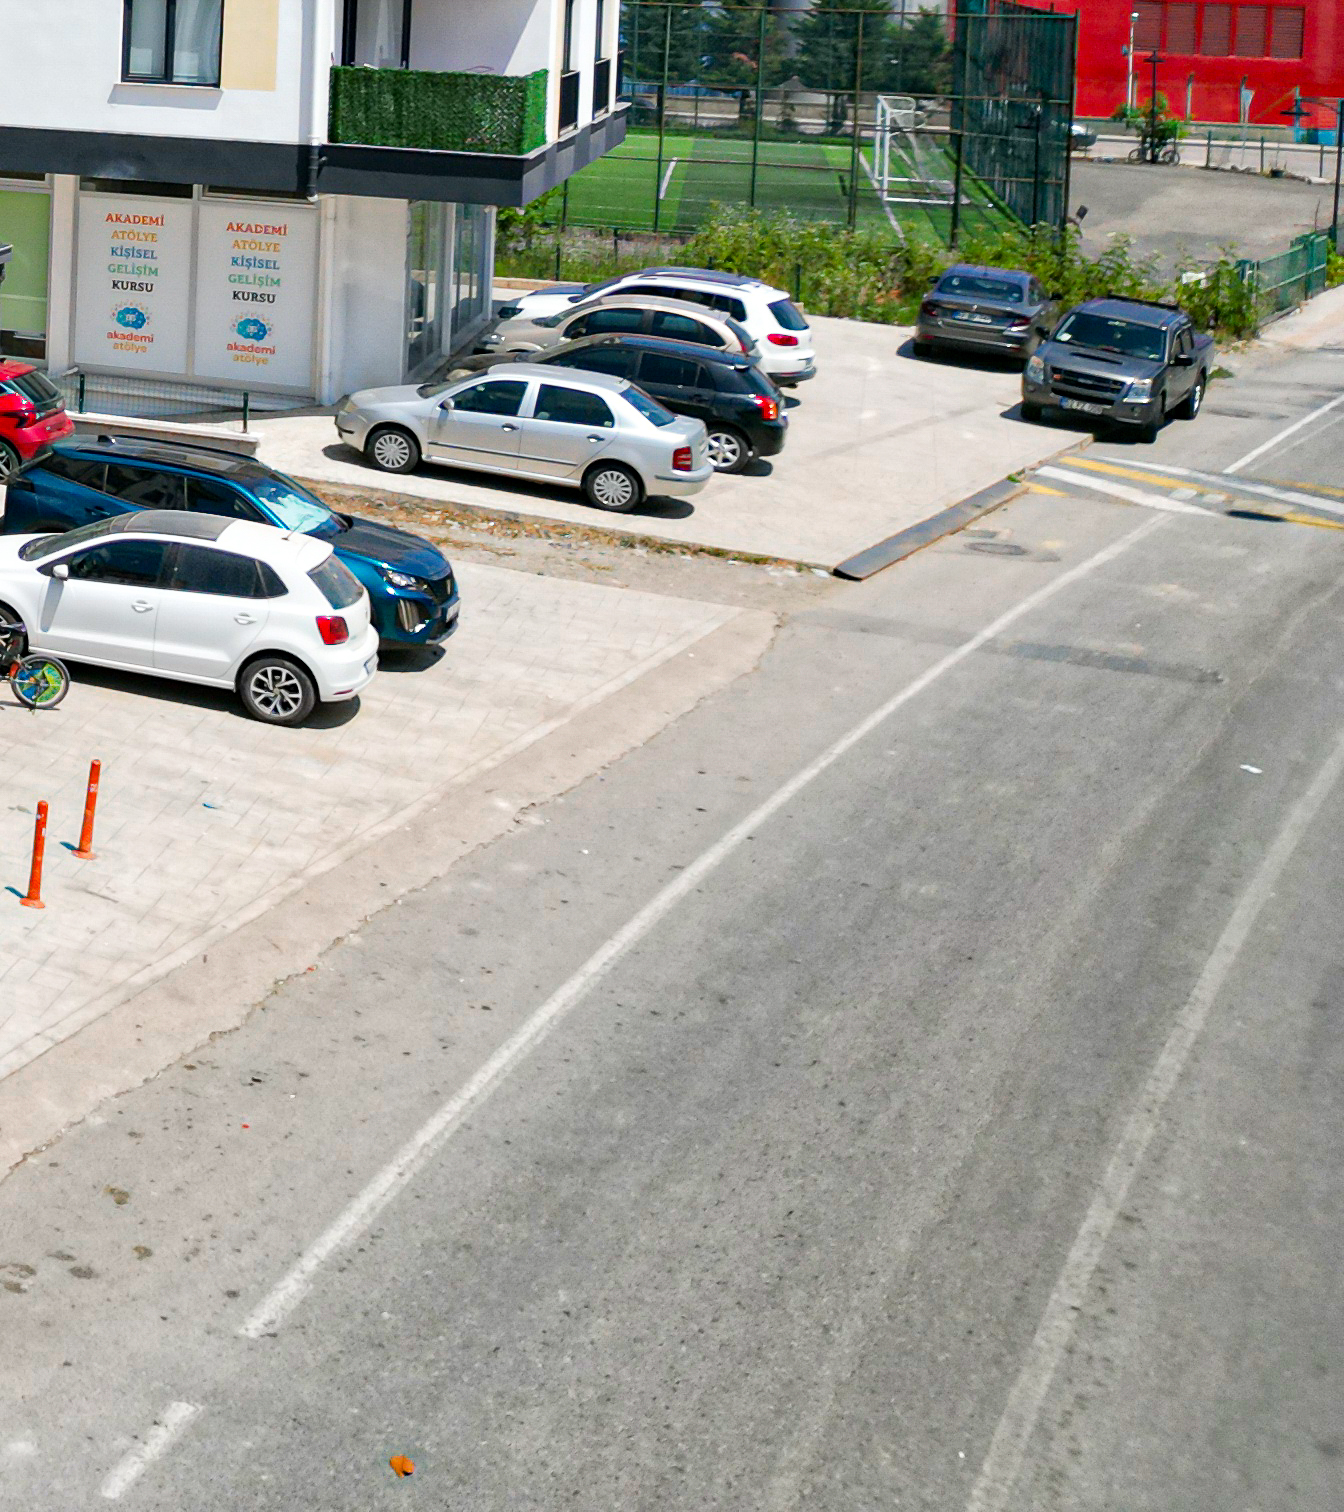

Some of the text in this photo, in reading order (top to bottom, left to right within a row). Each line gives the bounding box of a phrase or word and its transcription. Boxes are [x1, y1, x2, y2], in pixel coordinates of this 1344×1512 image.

[105, 212, 165, 227] AKADEMİ
[111, 229, 158, 243] ATÖLYE
[226, 221, 288, 237] AKADEMİ
[232, 238, 281, 253] ATÖLYE
[110, 245, 158, 261] KİŞİSEL
[230, 255, 280, 270] KİŞİSEL
[107, 262, 159, 279] GELİŞİM
[111, 279, 154, 293] KURSU
[227, 272, 281, 288] GELİŞİM
[232, 290, 276, 304] KURSU
[106, 331, 154, 344] akademi
[112, 341, 148, 354] atölye
[226, 342, 276, 355] akademi
[232, 353, 269, 367] atölye
